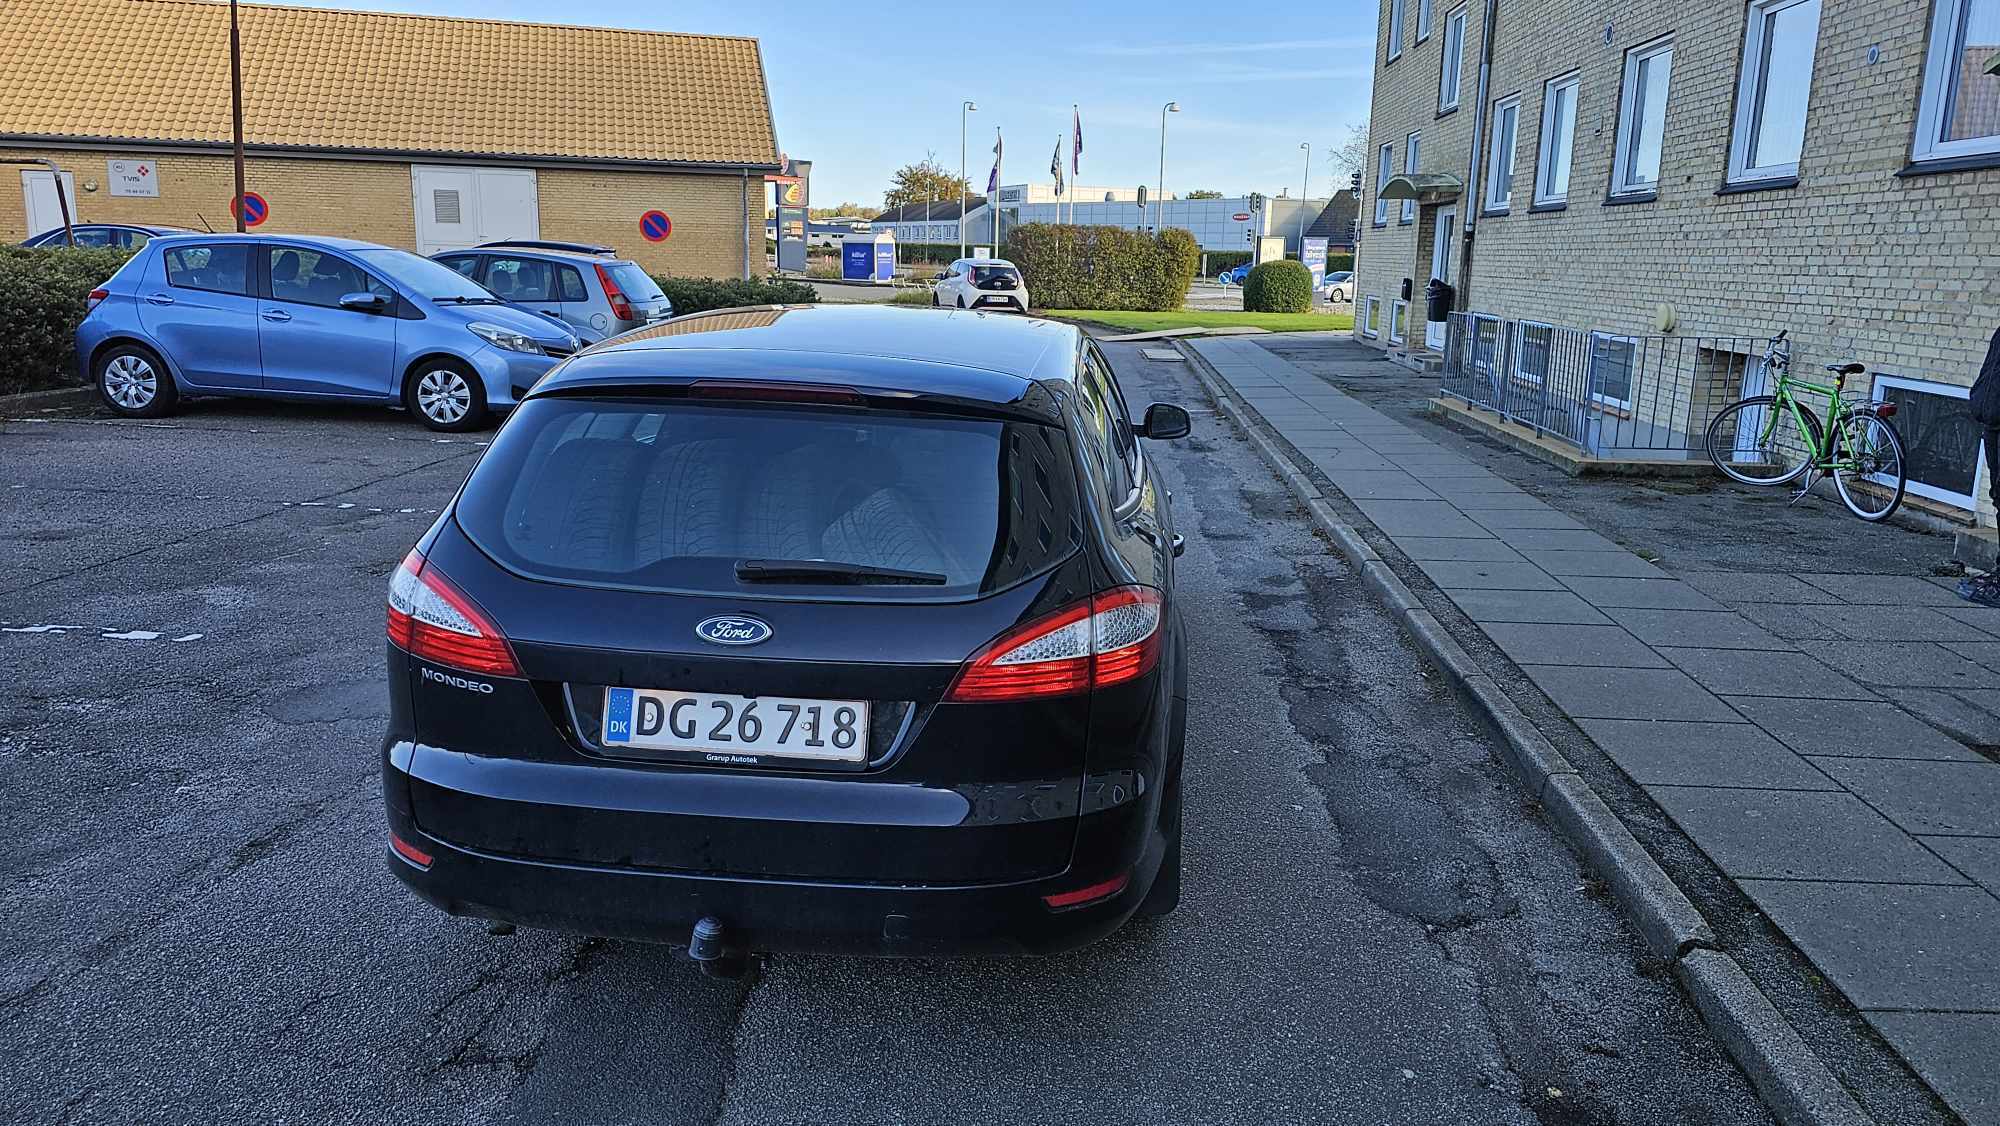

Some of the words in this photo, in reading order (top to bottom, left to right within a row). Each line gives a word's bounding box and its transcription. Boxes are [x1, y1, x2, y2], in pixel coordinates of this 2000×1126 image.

[711, 620, 755, 641] Ford
[421, 667, 495, 694] MONDEO
[610, 720, 627, 734] DK
[636, 695, 698, 740] DG
[708, 700, 763, 744] 26
[776, 704, 857, 750] 718
[706, 753, 730, 764] Grarup
[730, 755, 758, 764] Autotek
